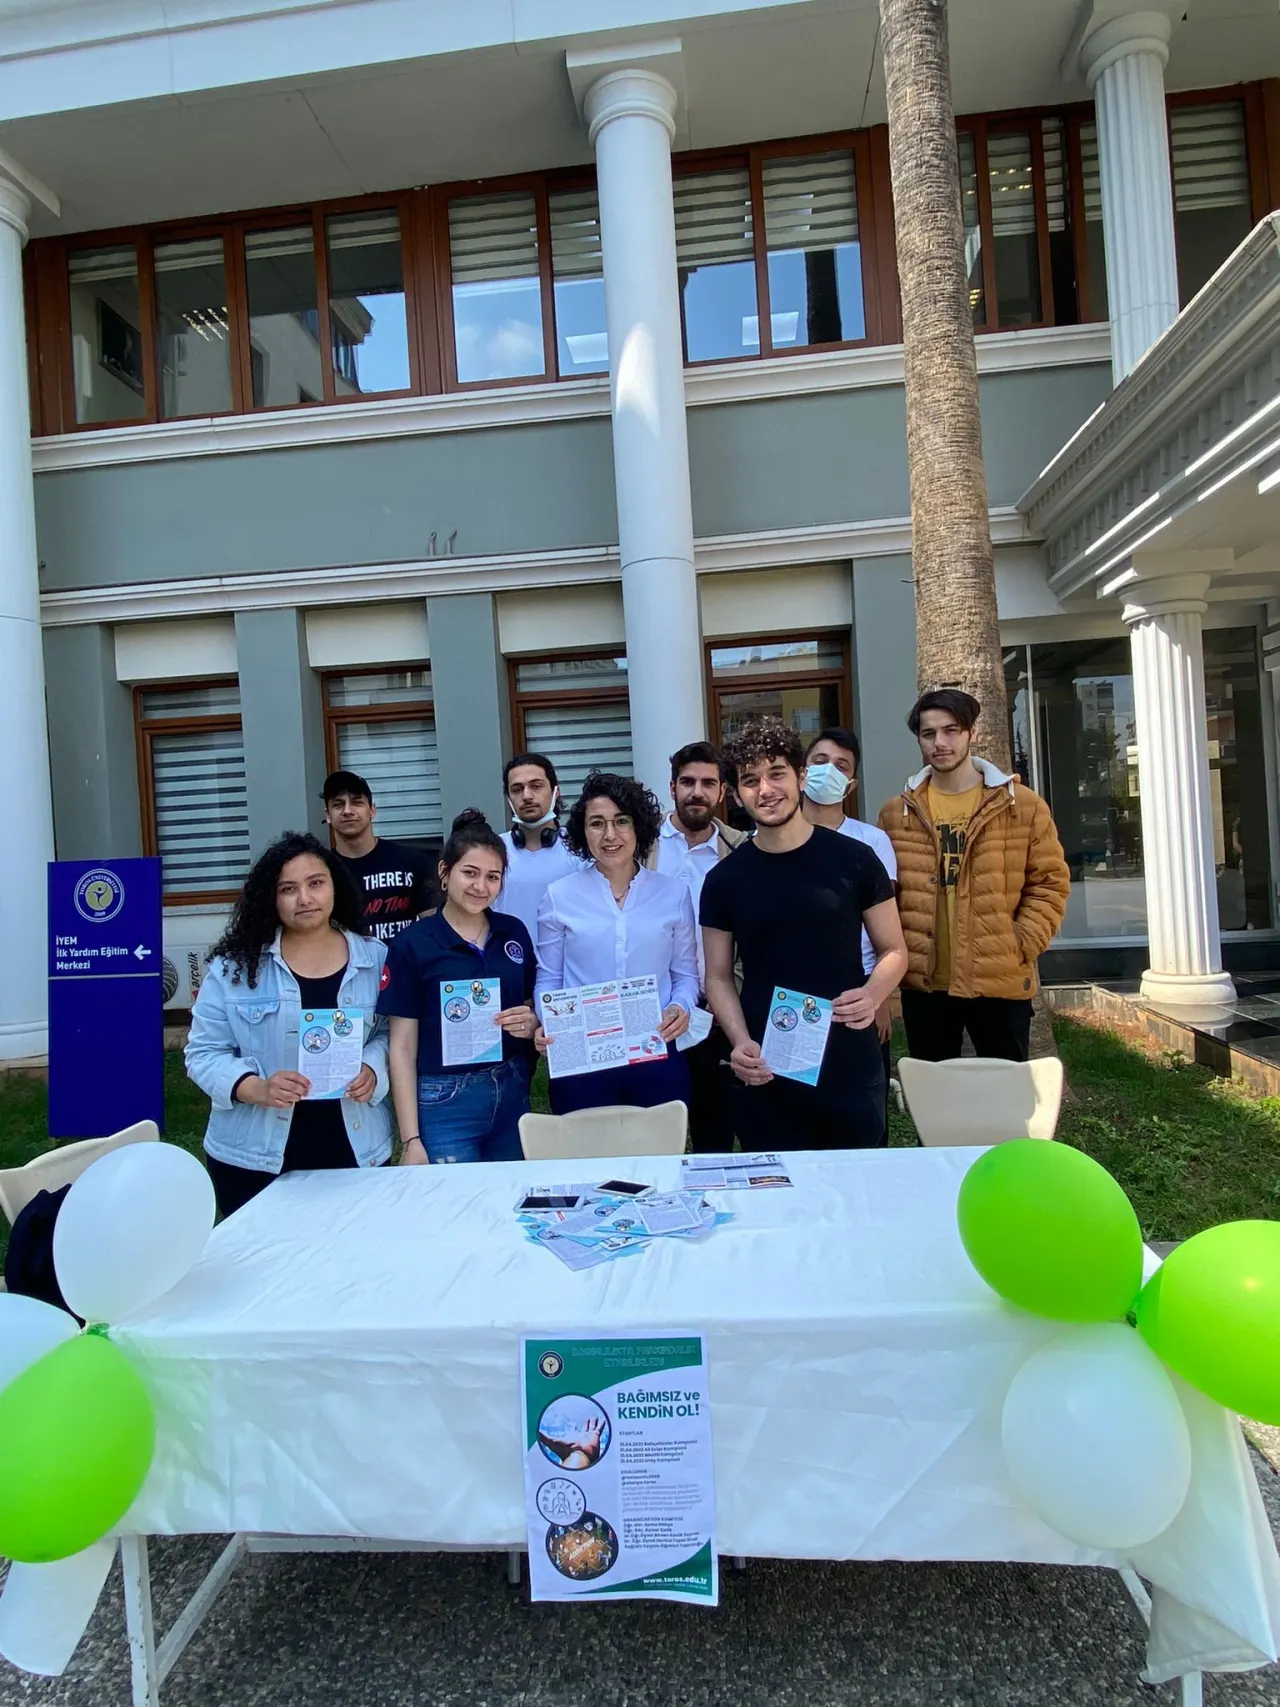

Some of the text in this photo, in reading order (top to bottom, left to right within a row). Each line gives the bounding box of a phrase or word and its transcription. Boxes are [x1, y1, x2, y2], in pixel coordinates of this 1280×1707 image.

[363, 871, 403, 891] THERE
[55, 935, 77, 946] İYEM
[56, 946, 128, 958] İlk Yardım Eğitim
[56, 960, 91, 970] Merkezi
[188, 951, 201, 988] arçelik
[617, 1389, 700, 1404] BAĞIMSIZ ve
[676, 1403, 700, 1417] OL!
